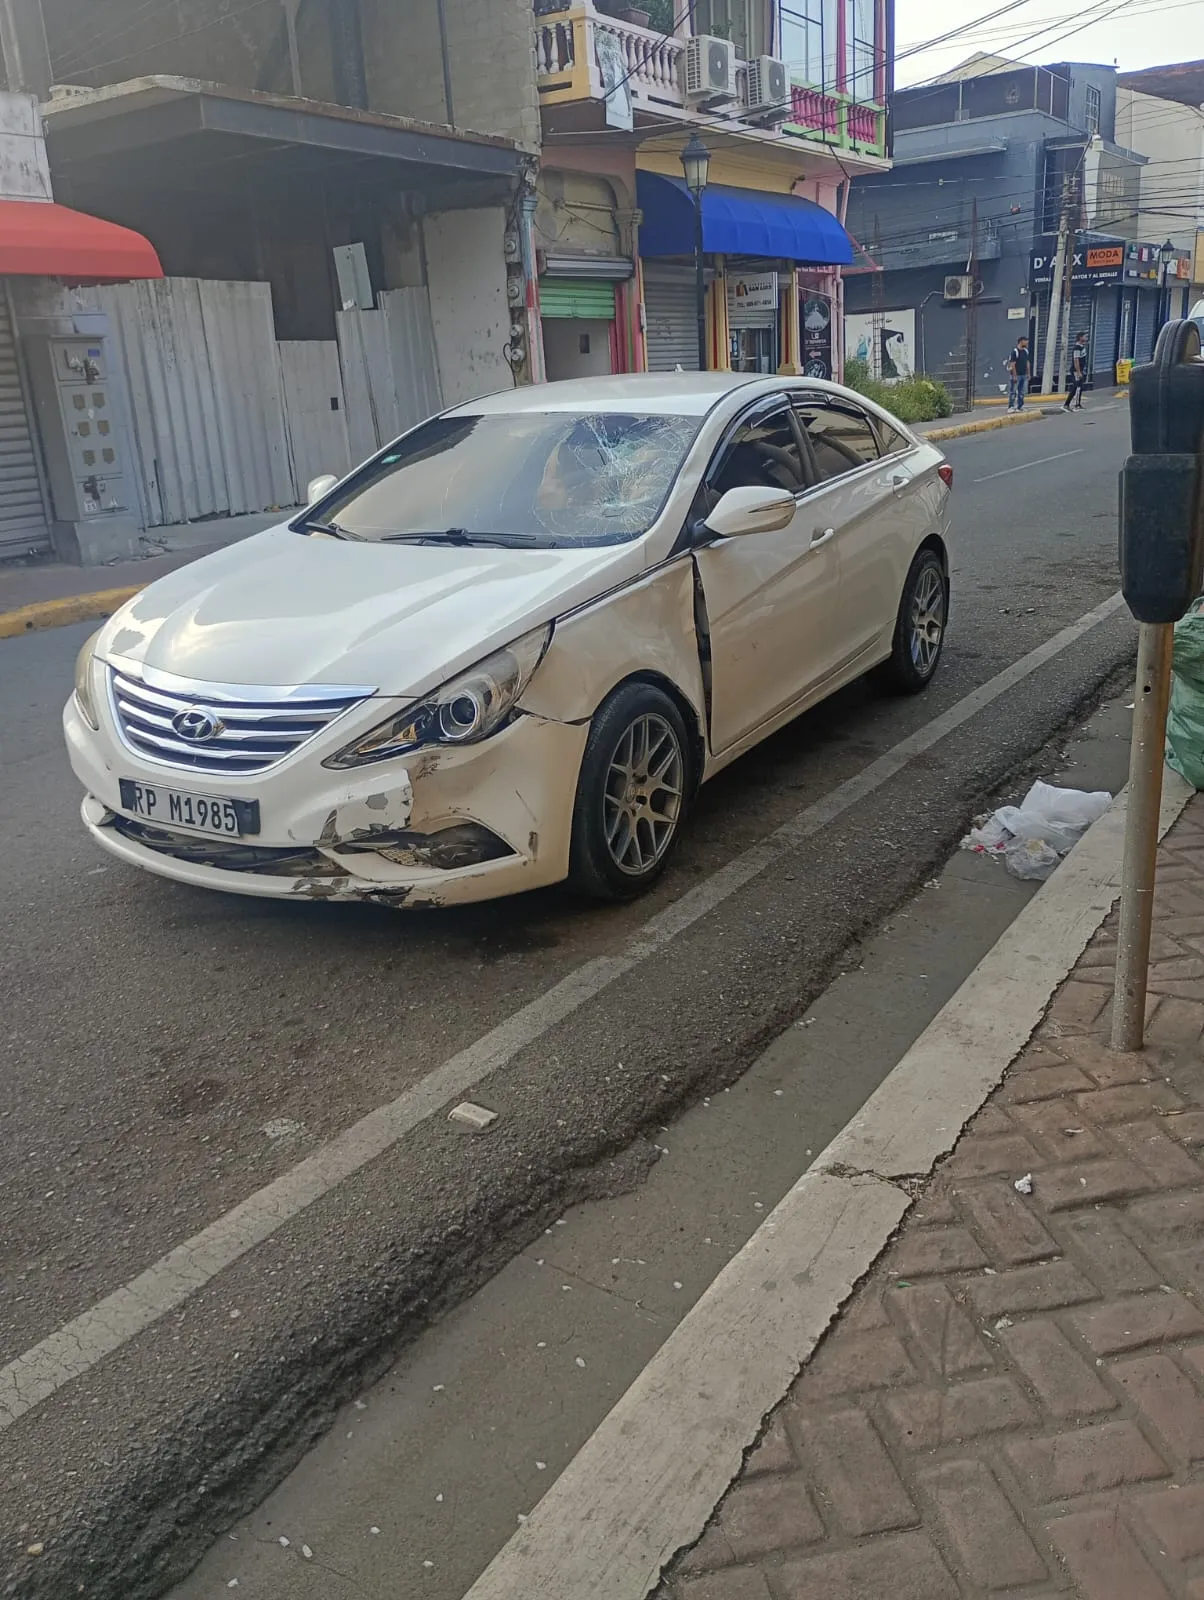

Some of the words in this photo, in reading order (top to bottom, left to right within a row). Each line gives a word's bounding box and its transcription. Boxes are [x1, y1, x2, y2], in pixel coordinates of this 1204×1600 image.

[1089, 250, 1119, 260] MODA
[133, 786, 157, 815] RP
[169, 793, 236, 832] M1985
